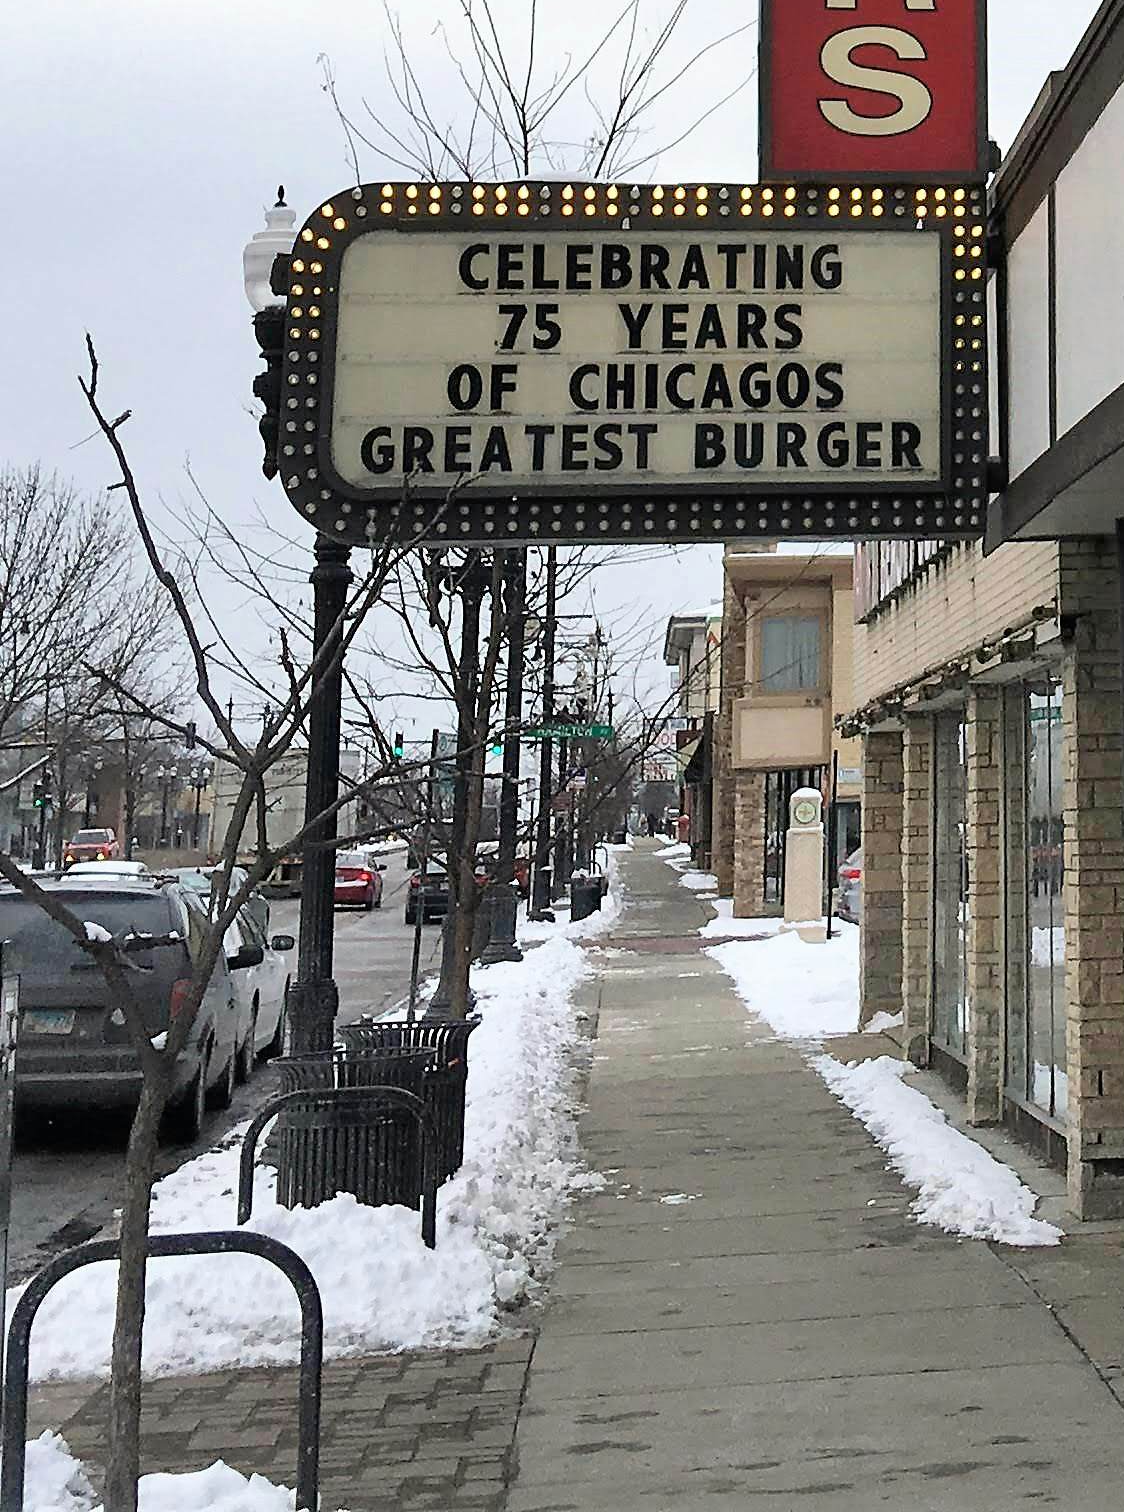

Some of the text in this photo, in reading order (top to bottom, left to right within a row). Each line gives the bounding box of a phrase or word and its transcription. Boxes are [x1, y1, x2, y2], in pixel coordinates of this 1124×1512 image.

[457, 243, 845, 291] CELEBRATING
[497, 303, 804, 351] 75 YEARS
[446, 362, 846, 412] OF CHICAGOS
[360, 420, 924, 474] GREATEST BURGER
